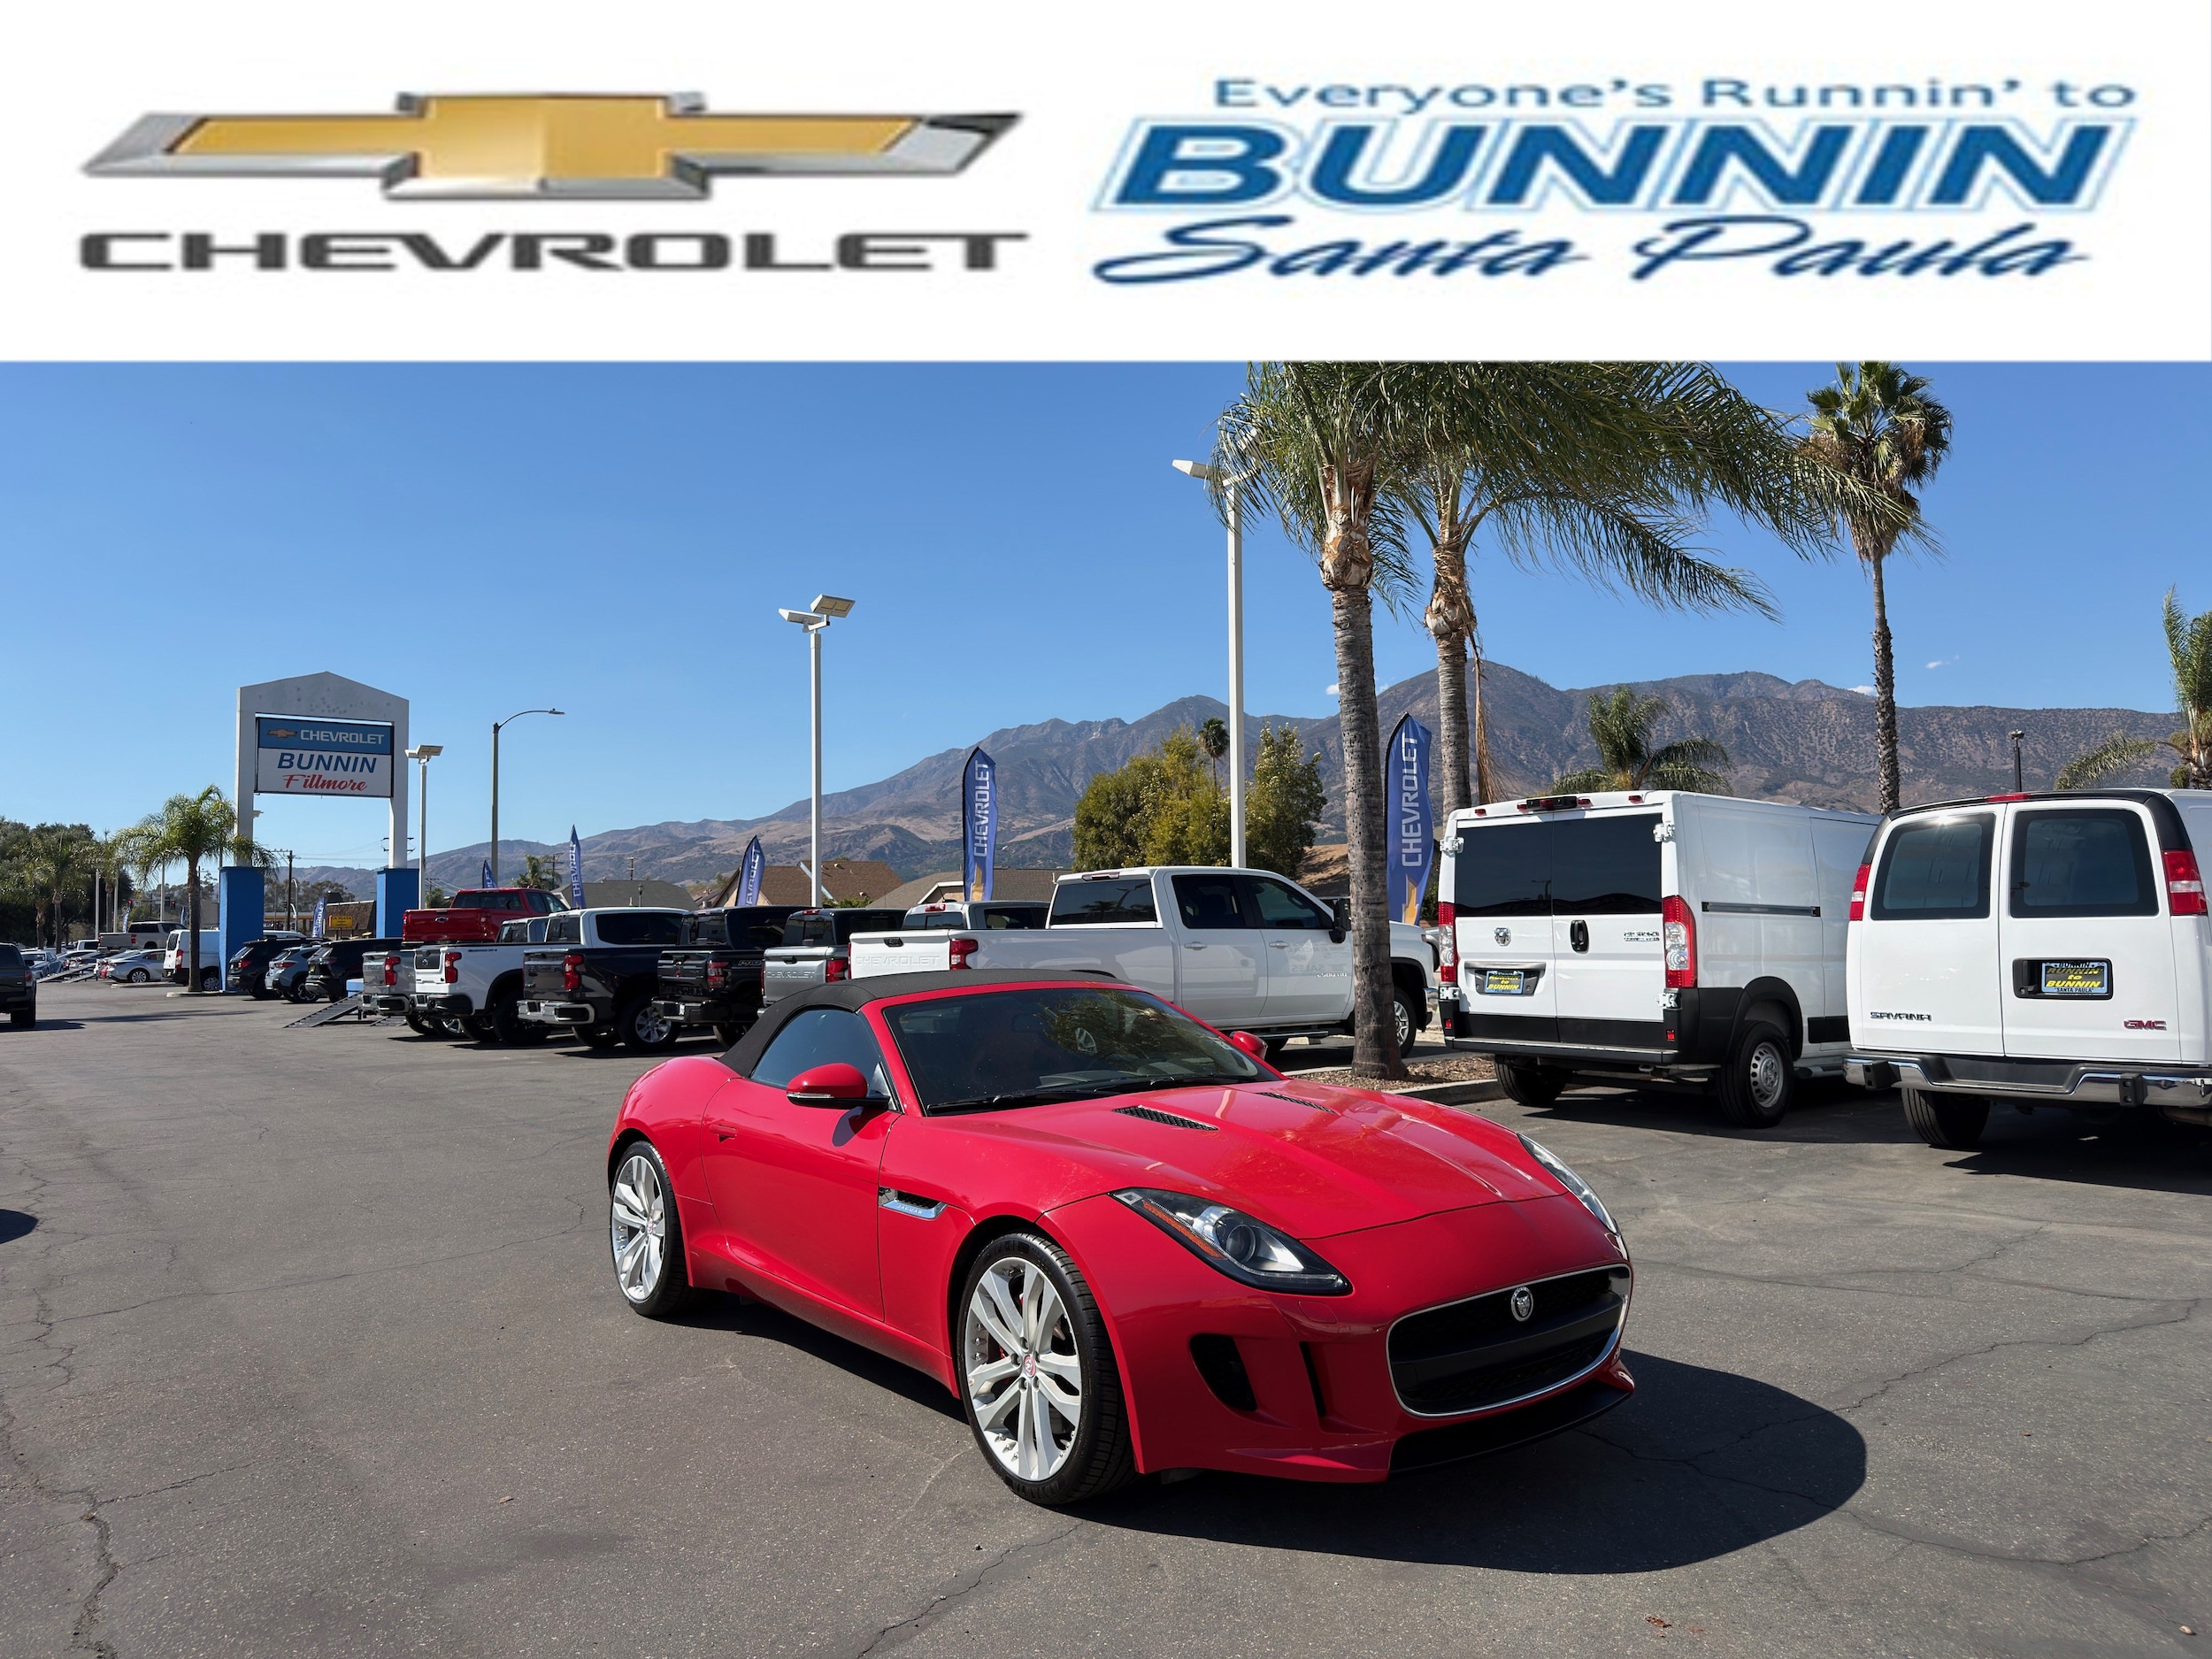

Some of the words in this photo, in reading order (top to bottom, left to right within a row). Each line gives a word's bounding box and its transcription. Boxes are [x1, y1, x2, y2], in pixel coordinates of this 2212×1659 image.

[301, 729, 385, 745] CHEVROLET
[278, 752, 377, 773] BUNNIN
[282, 774, 368, 792] Fillmore
[1402, 732, 1422, 867] CHEVROLET
[974, 760, 990, 857] CHEVROLET
[855, 955, 941, 966] CHEVROLET
[2046, 979, 2101, 988] BUNNIN
[1870, 1011, 1932, 1022] SAVANA
[2124, 1019, 2168, 1031] GMC
[896, 1204, 923, 1215] JAGUAR
